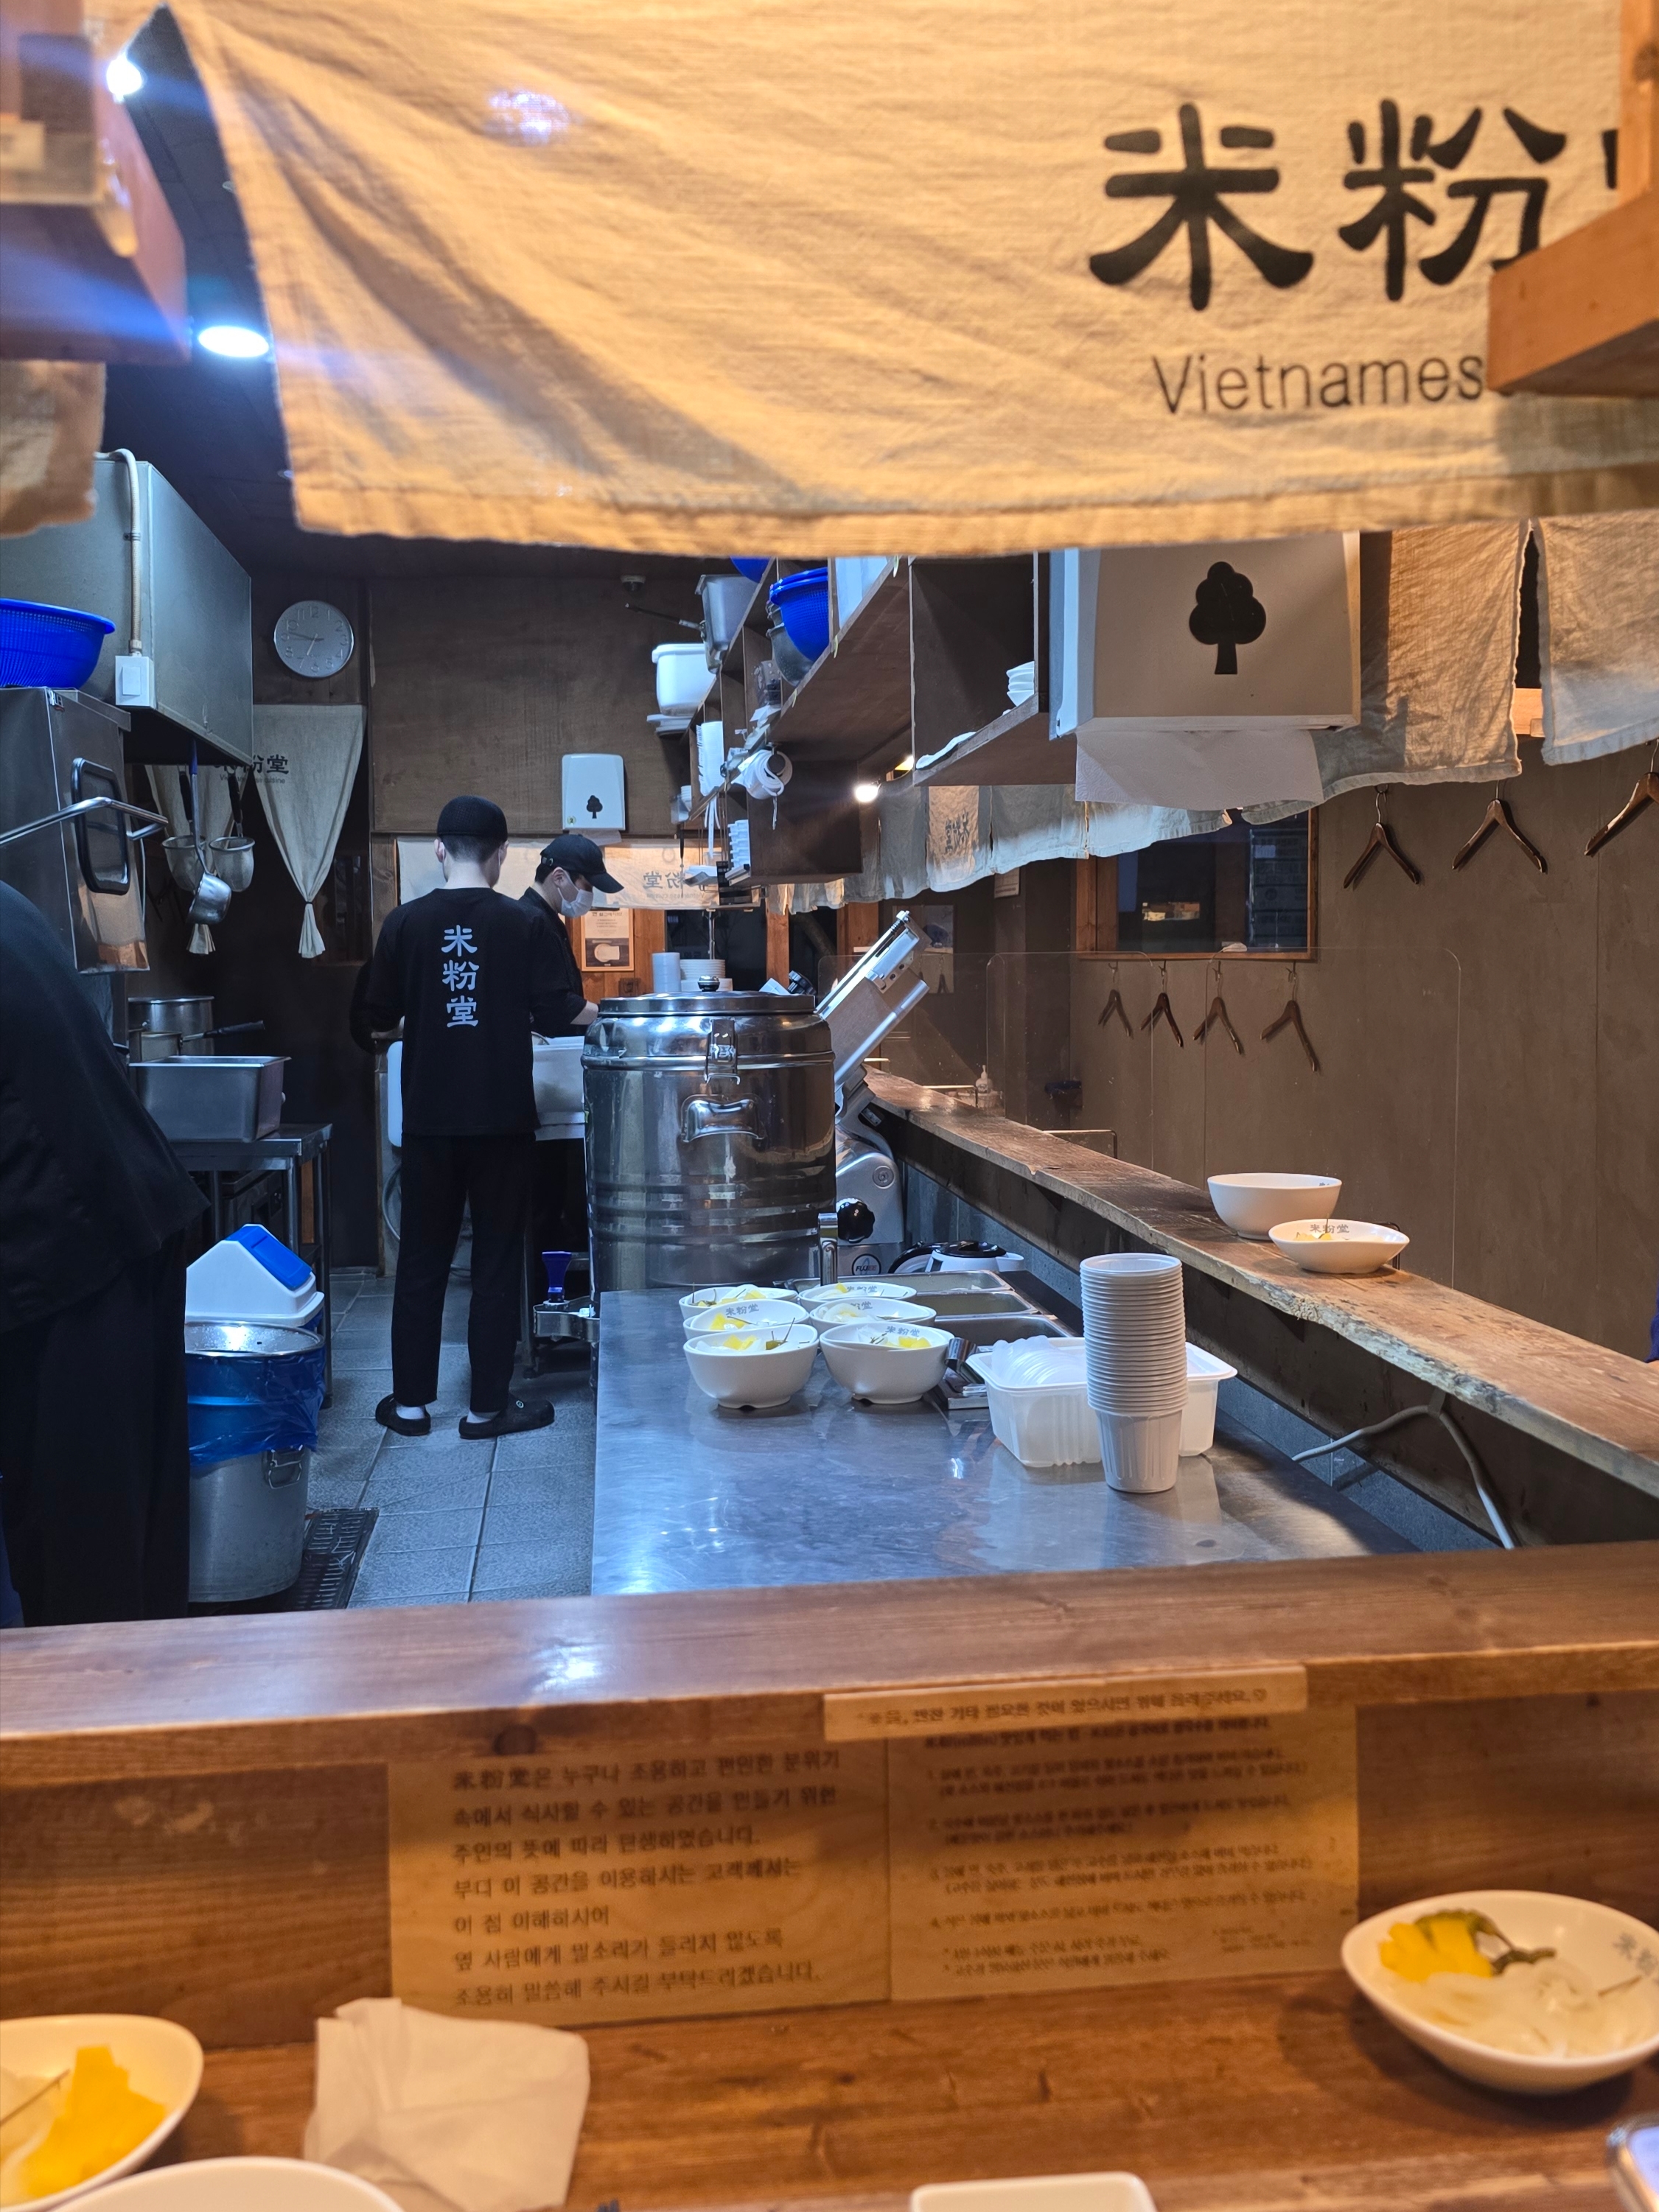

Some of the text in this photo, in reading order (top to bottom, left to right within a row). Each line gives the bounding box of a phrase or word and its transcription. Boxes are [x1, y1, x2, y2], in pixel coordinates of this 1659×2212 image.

[1089, 99, 1618, 312] 米粉
[1153, 354, 1503, 414] Vietnames
[441, 925, 480, 1028] 米粉堂
[1310, 1224, 1349, 1233] 米粉堂
[726, 1303, 759, 1316] 米粉堂
[885, 1326, 920, 1337] 米粉堂
[562, 1763, 616, 1786] 누구나
[632, 1758, 706, 1782] 조용하고
[592, 1799, 607, 1819] 수
[619, 1795, 655, 1818] 있는
[453, 1841, 511, 1863] 주인의
[571, 1835, 607, 1855] 따라
[455, 1878, 492, 1899] 부디
[503, 1876, 520, 1896] 이
[532, 1871, 588, 1895] 공간을
[600, 1863, 696, 1888] 이용하시는
[454, 1915, 472, 1935] 이
[511, 1904, 609, 1931] 이해하시어
[454, 1951, 472, 1971] 옆
[484, 1943, 562, 1970] 사람에게
[570, 1937, 648, 1964] 말소리가
[593, 1973, 650, 1998] 주시길
